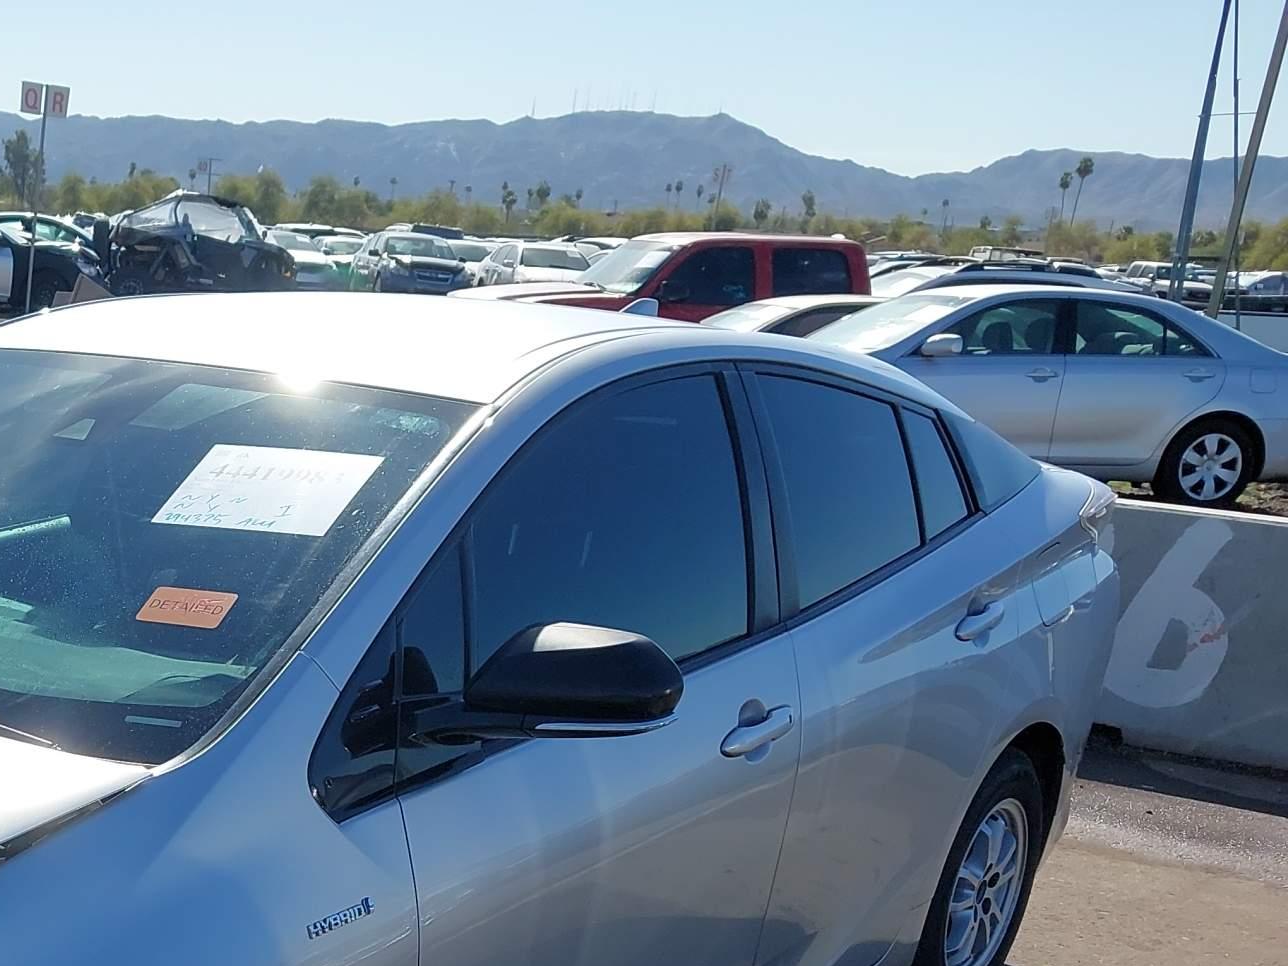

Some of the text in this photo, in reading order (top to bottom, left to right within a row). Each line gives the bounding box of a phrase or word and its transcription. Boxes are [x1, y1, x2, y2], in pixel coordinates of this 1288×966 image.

[24, 87, 38, 110] Q
[52, 91, 65, 113] R
[307, 903, 366, 939] HYBRID
